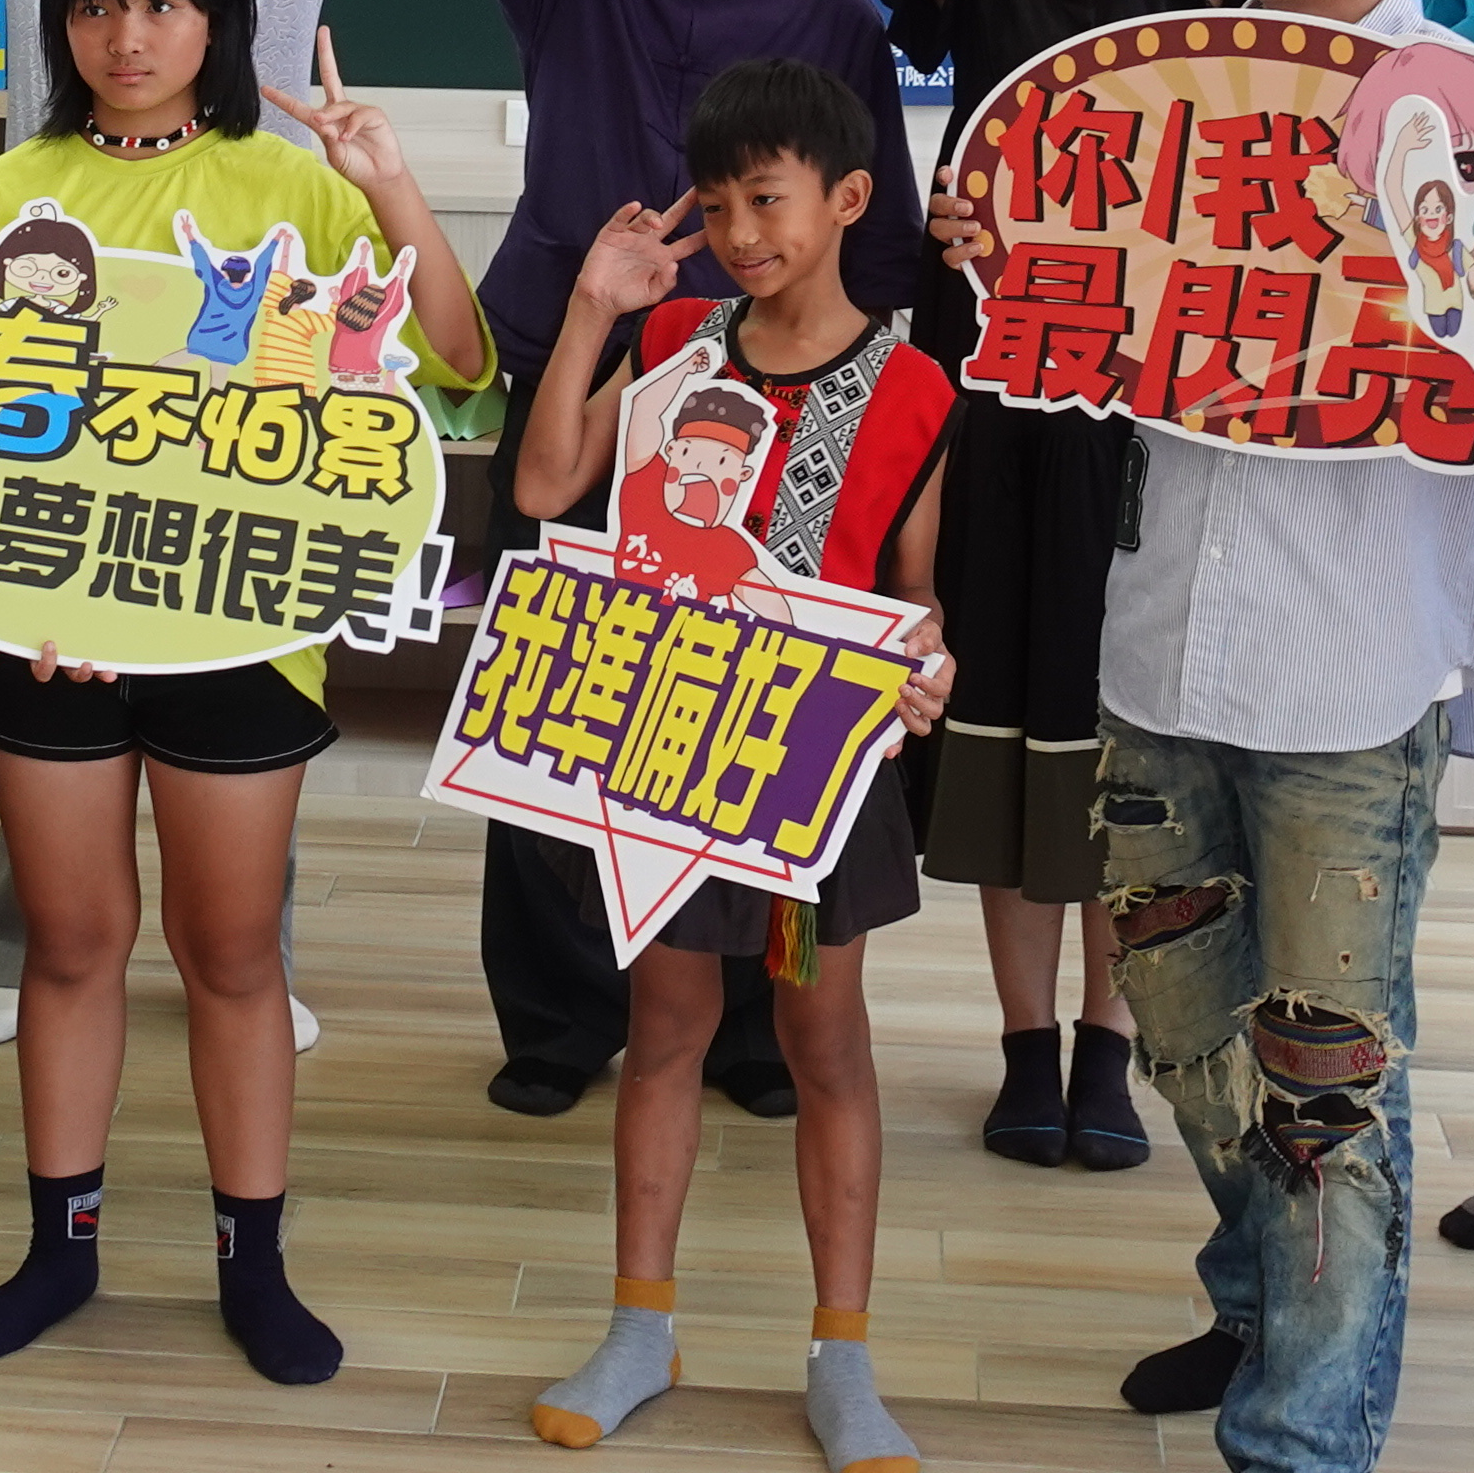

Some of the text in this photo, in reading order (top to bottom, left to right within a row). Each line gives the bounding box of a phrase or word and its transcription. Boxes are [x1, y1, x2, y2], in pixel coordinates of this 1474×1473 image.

[461, 567, 913, 859] 我準備好了
